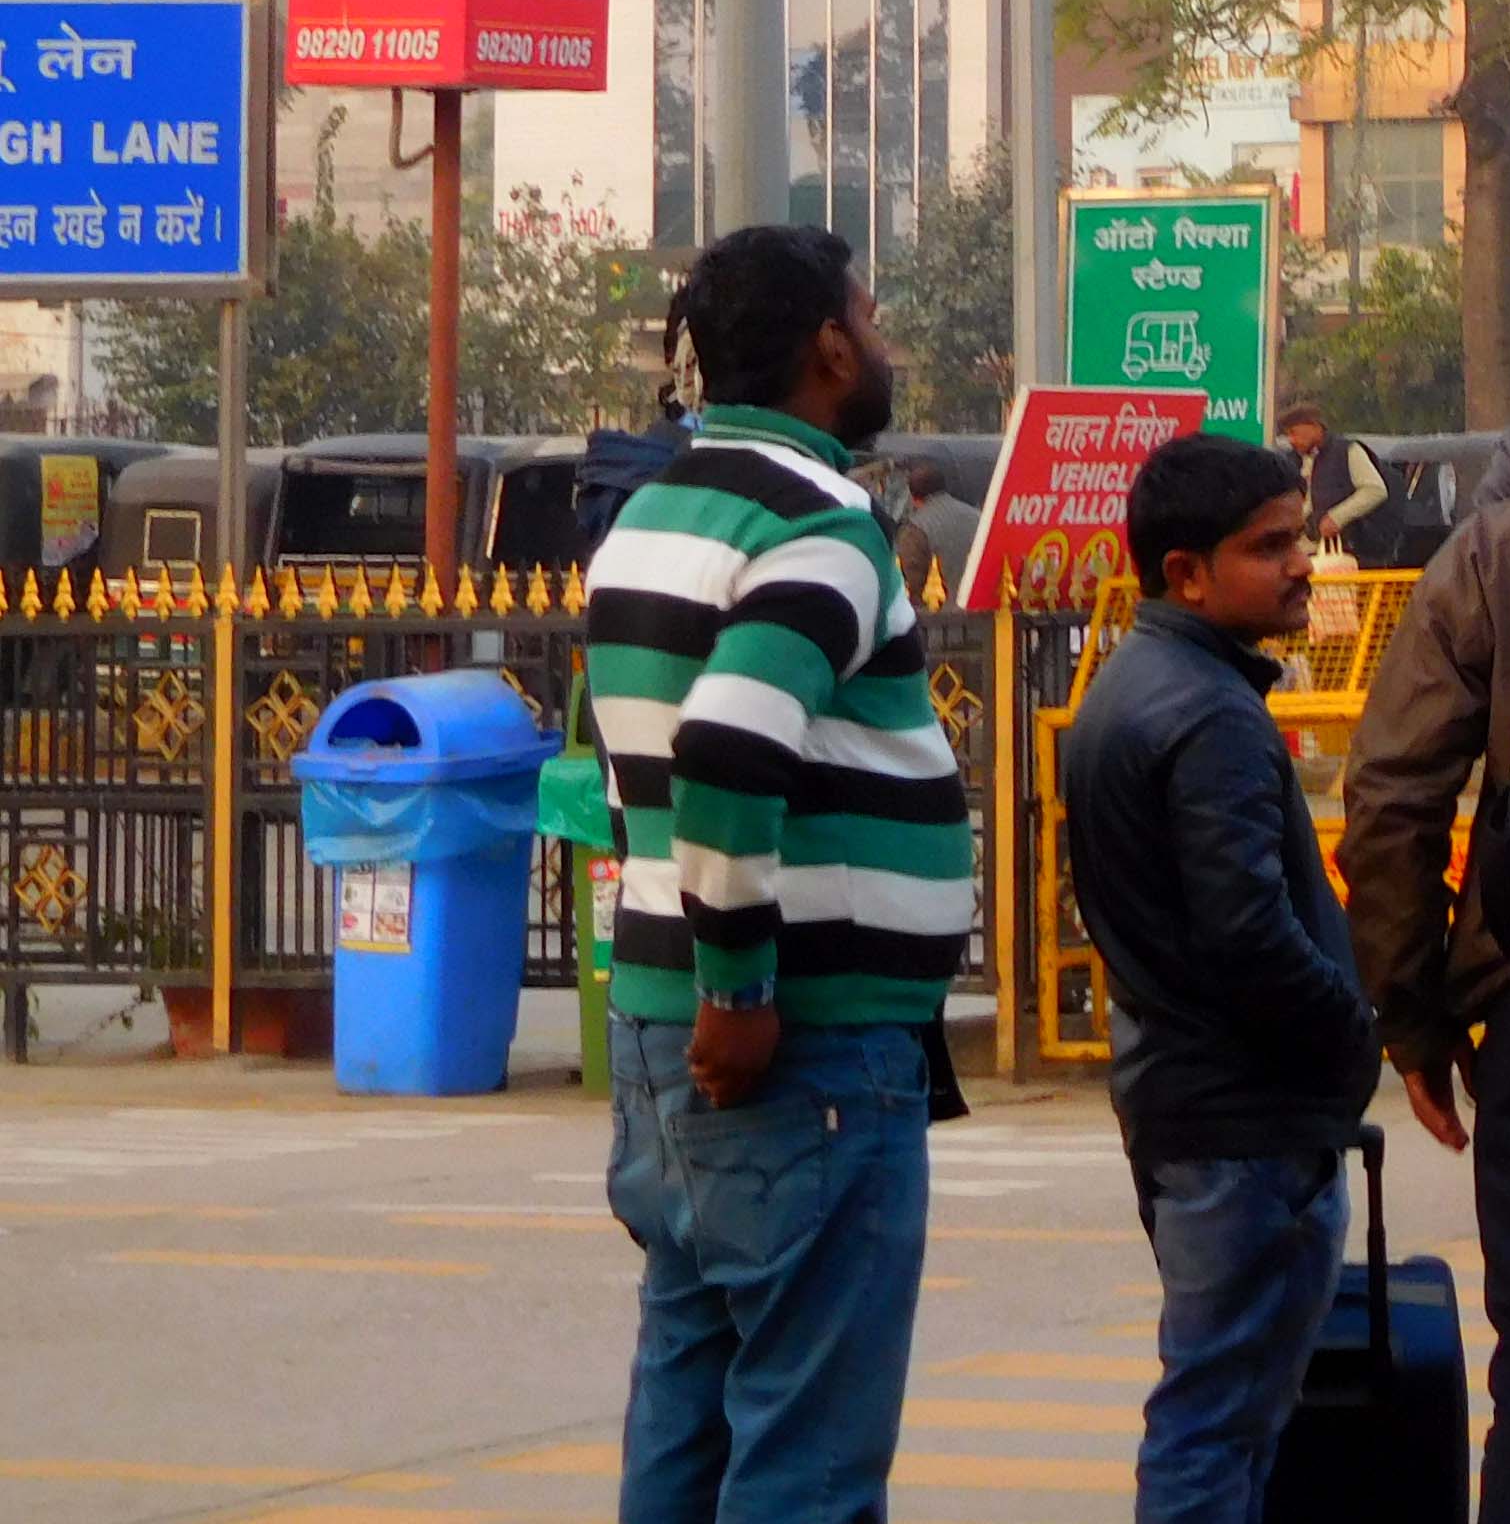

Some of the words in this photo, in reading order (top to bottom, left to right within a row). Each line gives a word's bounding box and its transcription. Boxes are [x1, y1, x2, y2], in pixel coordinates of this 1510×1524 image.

[36, 20, 137, 80] लेन
[296, 27, 366, 60] 98290
[372, 27, 441, 61] 11005
[476, 31, 533, 63] 98290
[537, 33, 593, 68] 11005
[91, 120, 220, 165] LANE
[117, 204, 143, 245] न
[1094, 215, 1158, 252] ऑटो
[1172, 215, 1251, 250] रिक्शा
[1046, 413, 1111, 458] वाहन
[1006, 494, 1059, 526] NOT
